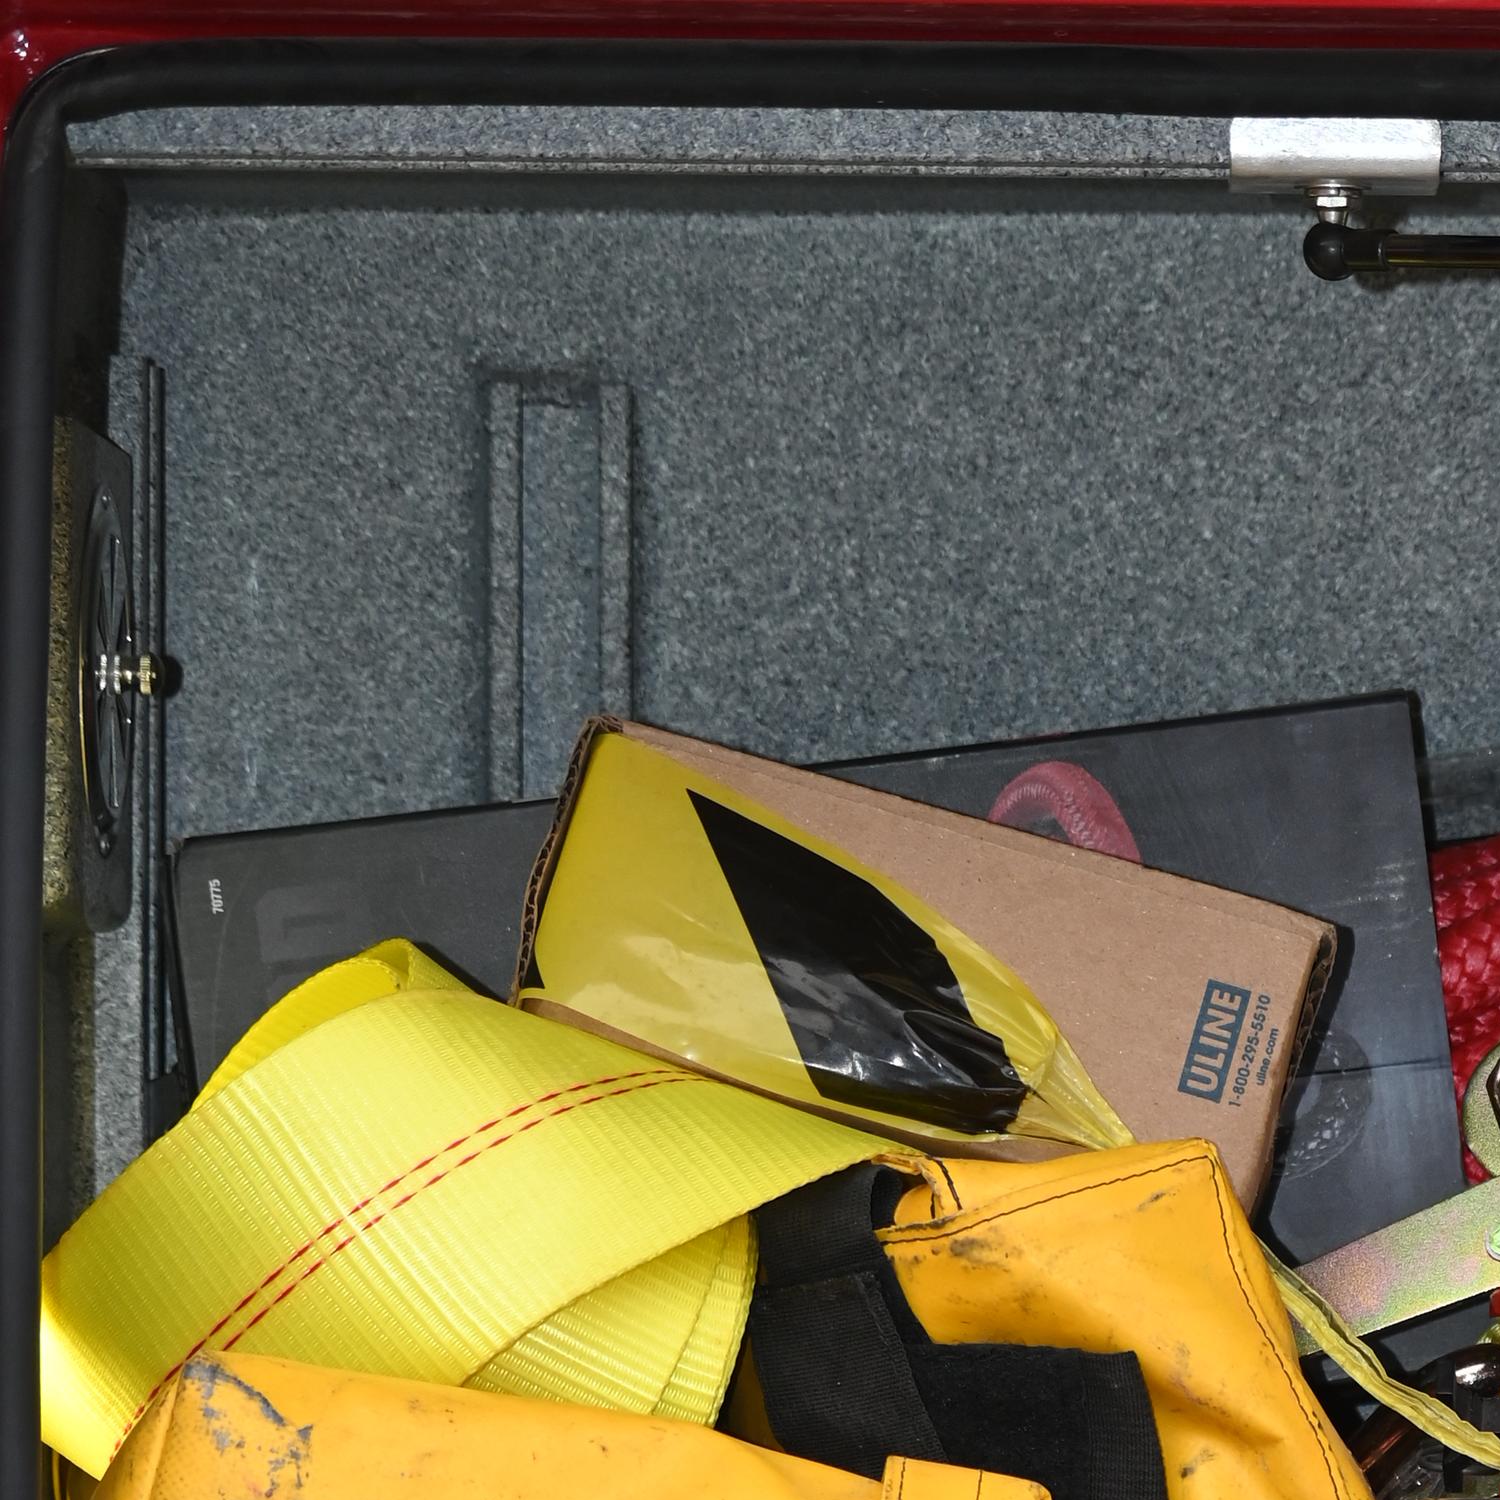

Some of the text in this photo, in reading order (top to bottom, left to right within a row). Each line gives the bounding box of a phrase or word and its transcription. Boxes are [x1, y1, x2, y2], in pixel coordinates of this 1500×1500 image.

[208, 878, 224, 915] 70775
[1185, 987, 1243, 1094] ULINE
[1257, 1027, 1279, 1086] uline.com
